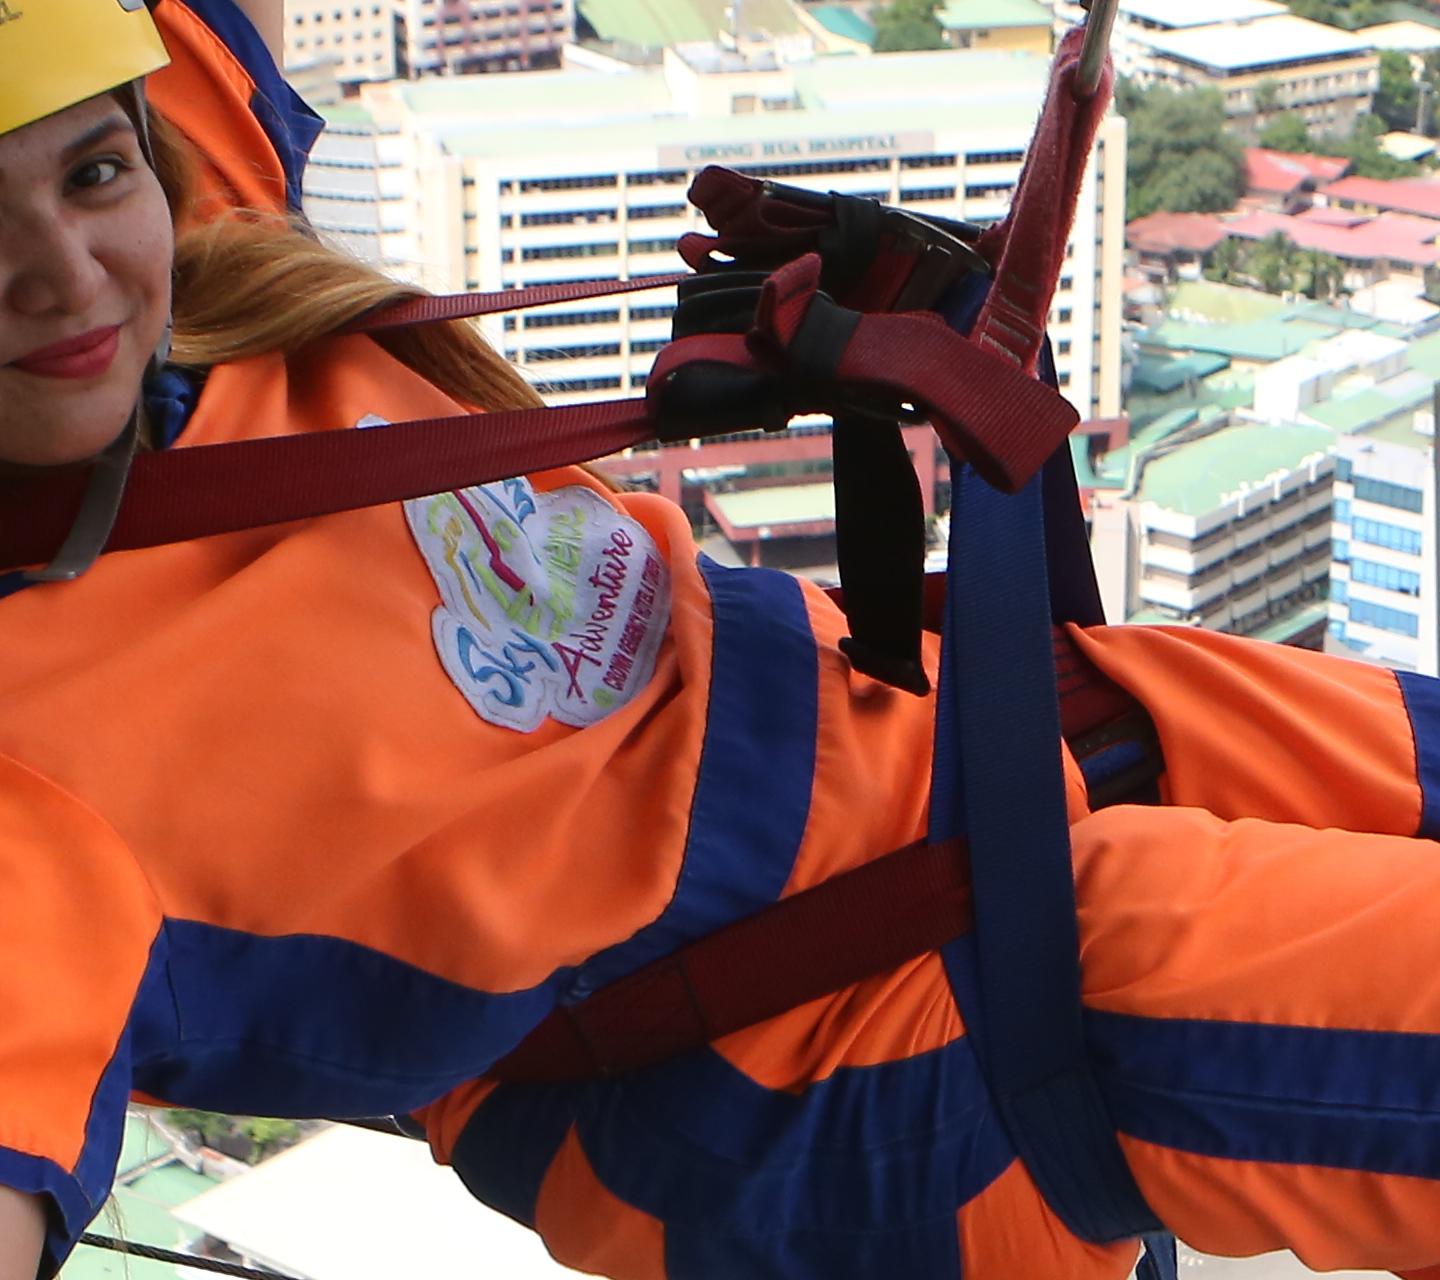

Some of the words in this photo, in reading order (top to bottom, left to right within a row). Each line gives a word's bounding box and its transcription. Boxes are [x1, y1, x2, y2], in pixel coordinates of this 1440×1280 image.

[684, 144, 753, 161] CHONG
[763, 140, 801, 156] HUA
[808, 134, 900, 153] HOSPITAL
[551, 528, 634, 701] Adventure
